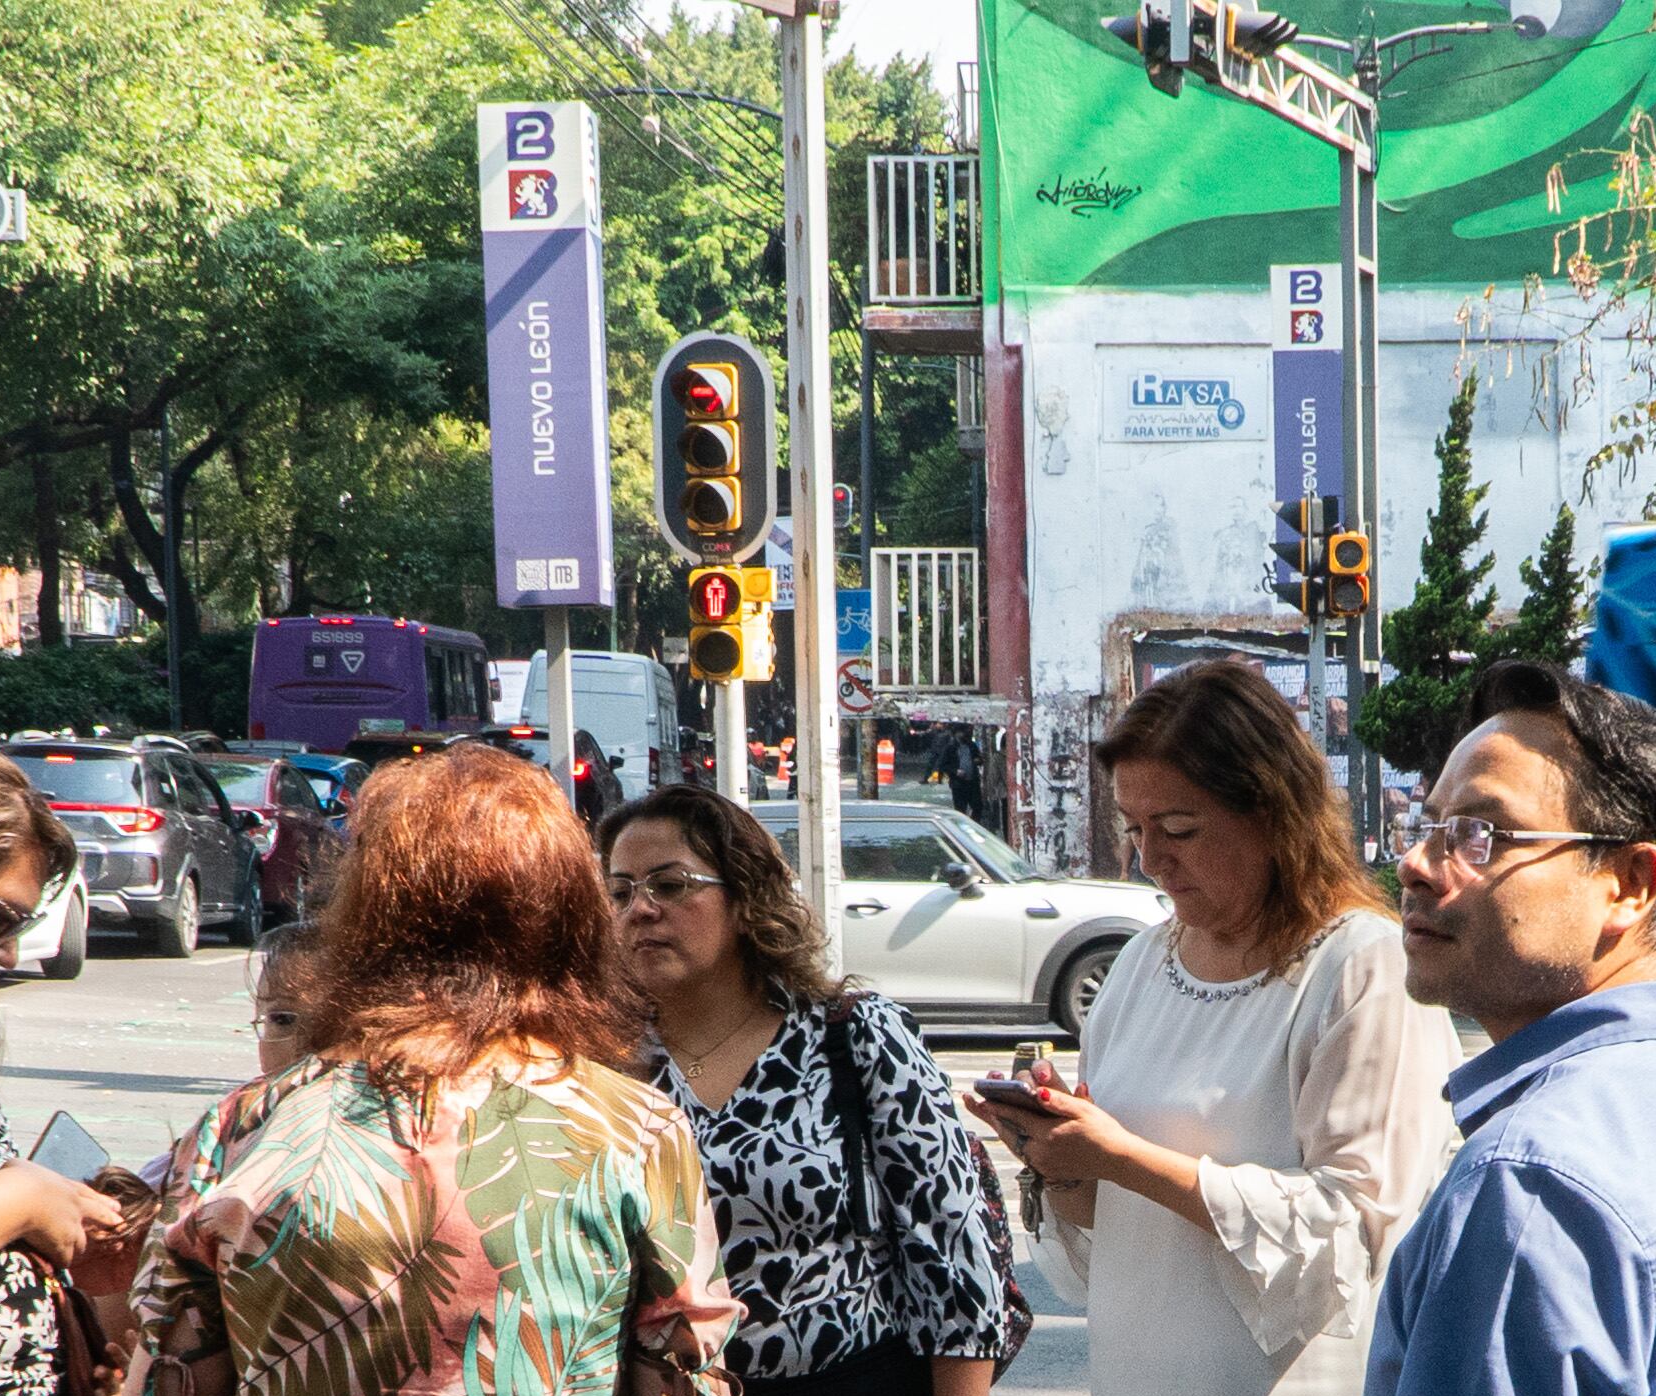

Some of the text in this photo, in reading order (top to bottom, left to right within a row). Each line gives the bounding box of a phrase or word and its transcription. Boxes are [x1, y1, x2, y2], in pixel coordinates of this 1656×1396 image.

[1137, 370, 1225, 404] RAKSA
[1125, 424, 1220, 438] PARA VERTE MÁS
[312, 631, 364, 643] 651899
